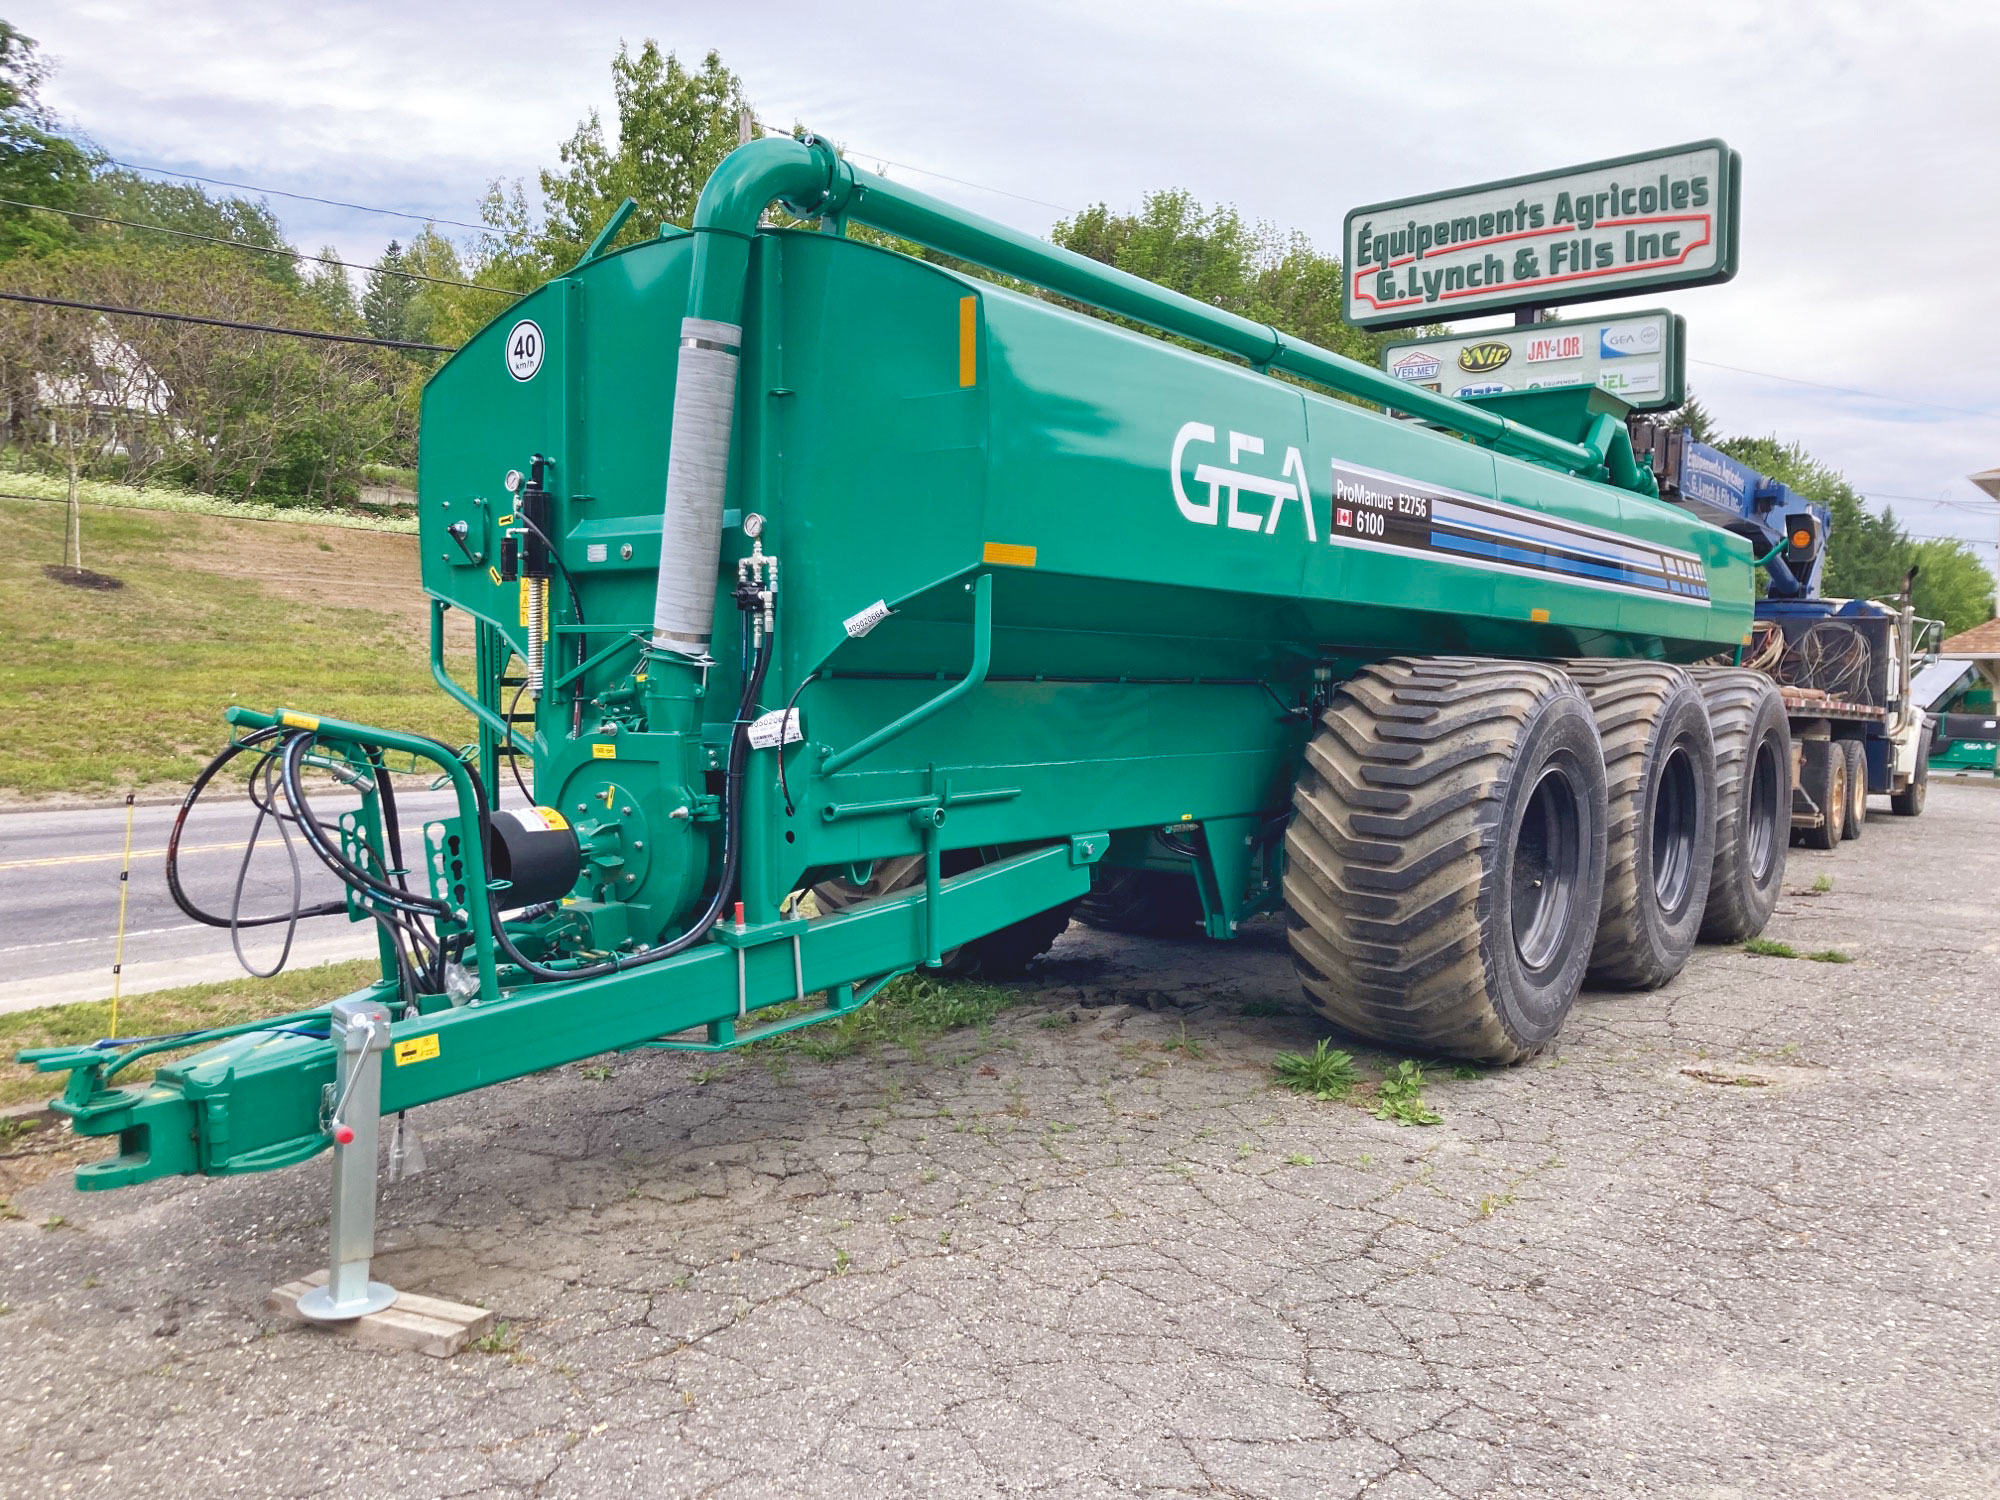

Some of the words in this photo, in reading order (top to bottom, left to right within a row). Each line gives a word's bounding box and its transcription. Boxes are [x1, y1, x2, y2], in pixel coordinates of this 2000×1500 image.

[1357, 199, 1545, 269] Équipements
[1553, 174, 1710, 231] Agricoles
[1513, 247, 1541, 280] &
[1550, 238, 1614, 275] Fils
[1625, 230, 1682, 263] Inc
[514, 334, 536, 359] 40
[1610, 335, 1635, 345] GEA
[516, 360, 535, 369] km/h
[1171, 421, 1317, 542] GEA
[1336, 478, 1394, 511] ProManure
[1399, 493, 1427, 517] E2756
[1356, 510, 1385, 536] 6100
